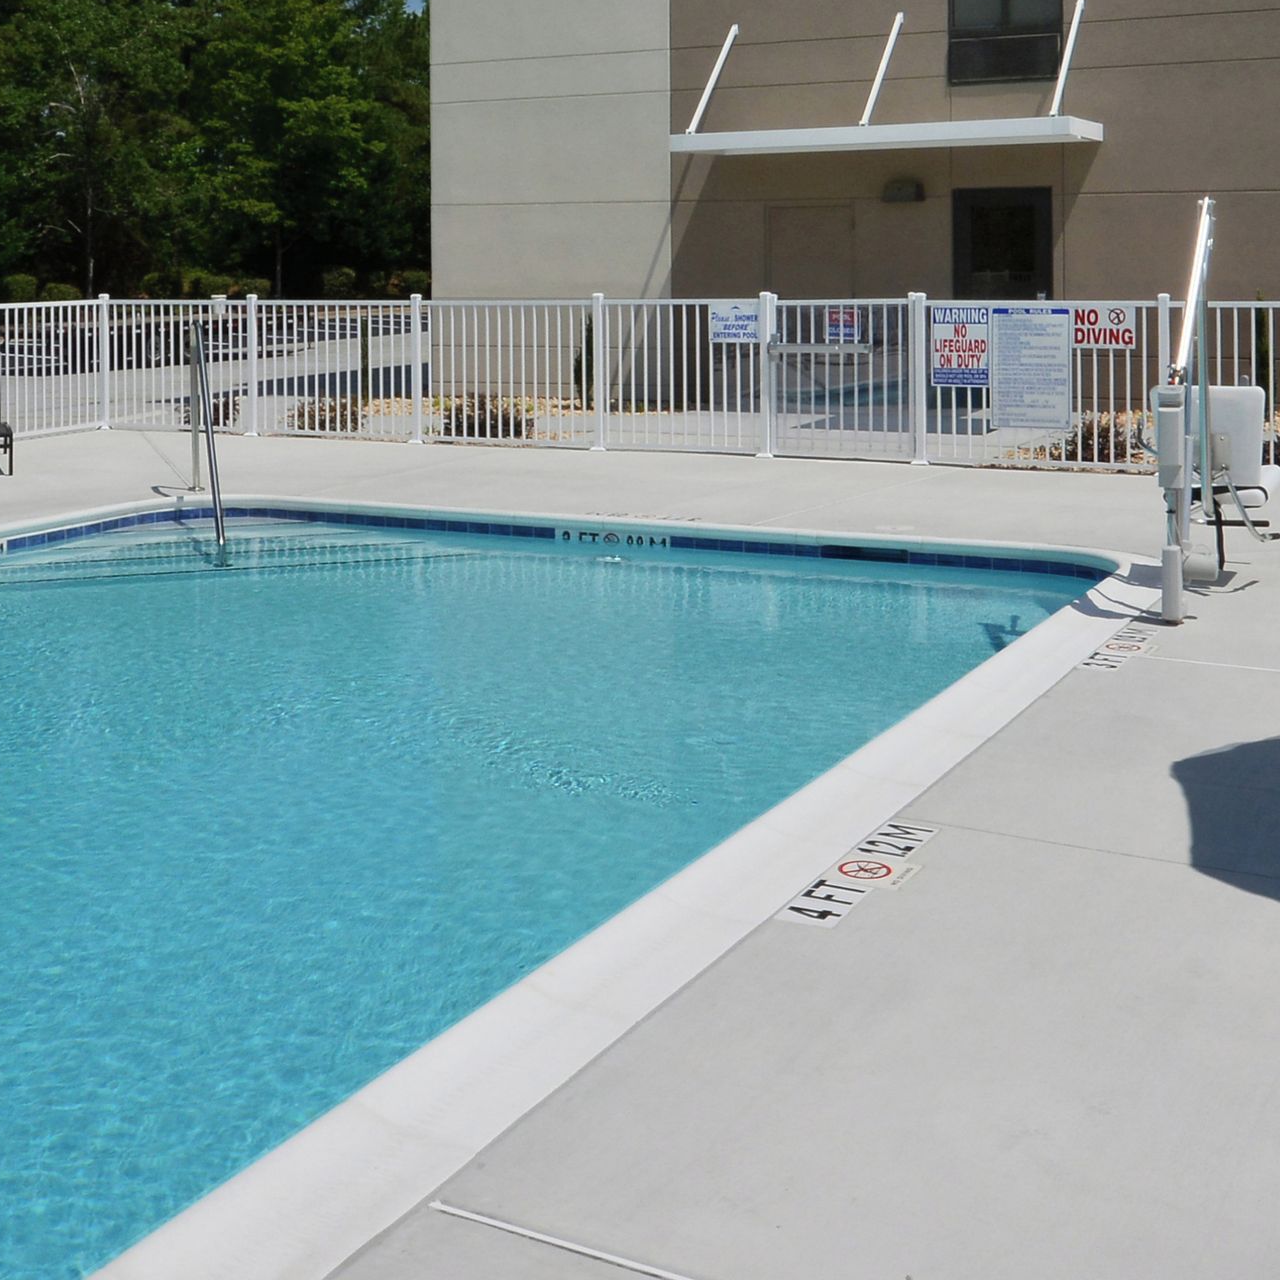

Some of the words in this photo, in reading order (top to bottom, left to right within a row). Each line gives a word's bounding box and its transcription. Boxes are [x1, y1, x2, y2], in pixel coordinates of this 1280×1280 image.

[734, 314, 758, 322] SHOWER
[934, 308, 987, 323] WARNING
[1074, 309, 1099, 326] NO
[712, 331, 741, 339] ENTERING
[742, 331, 758, 339] POOL
[953, 324, 968, 339] NO
[1074, 328, 1134, 345] DIVING
[934, 339, 987, 353] LIFEGUARD
[939, 354, 953, 368] ON
[957, 354, 982, 368] DUTY
[801, 879, 866, 905] FT
[787, 906, 842, 920] 4
